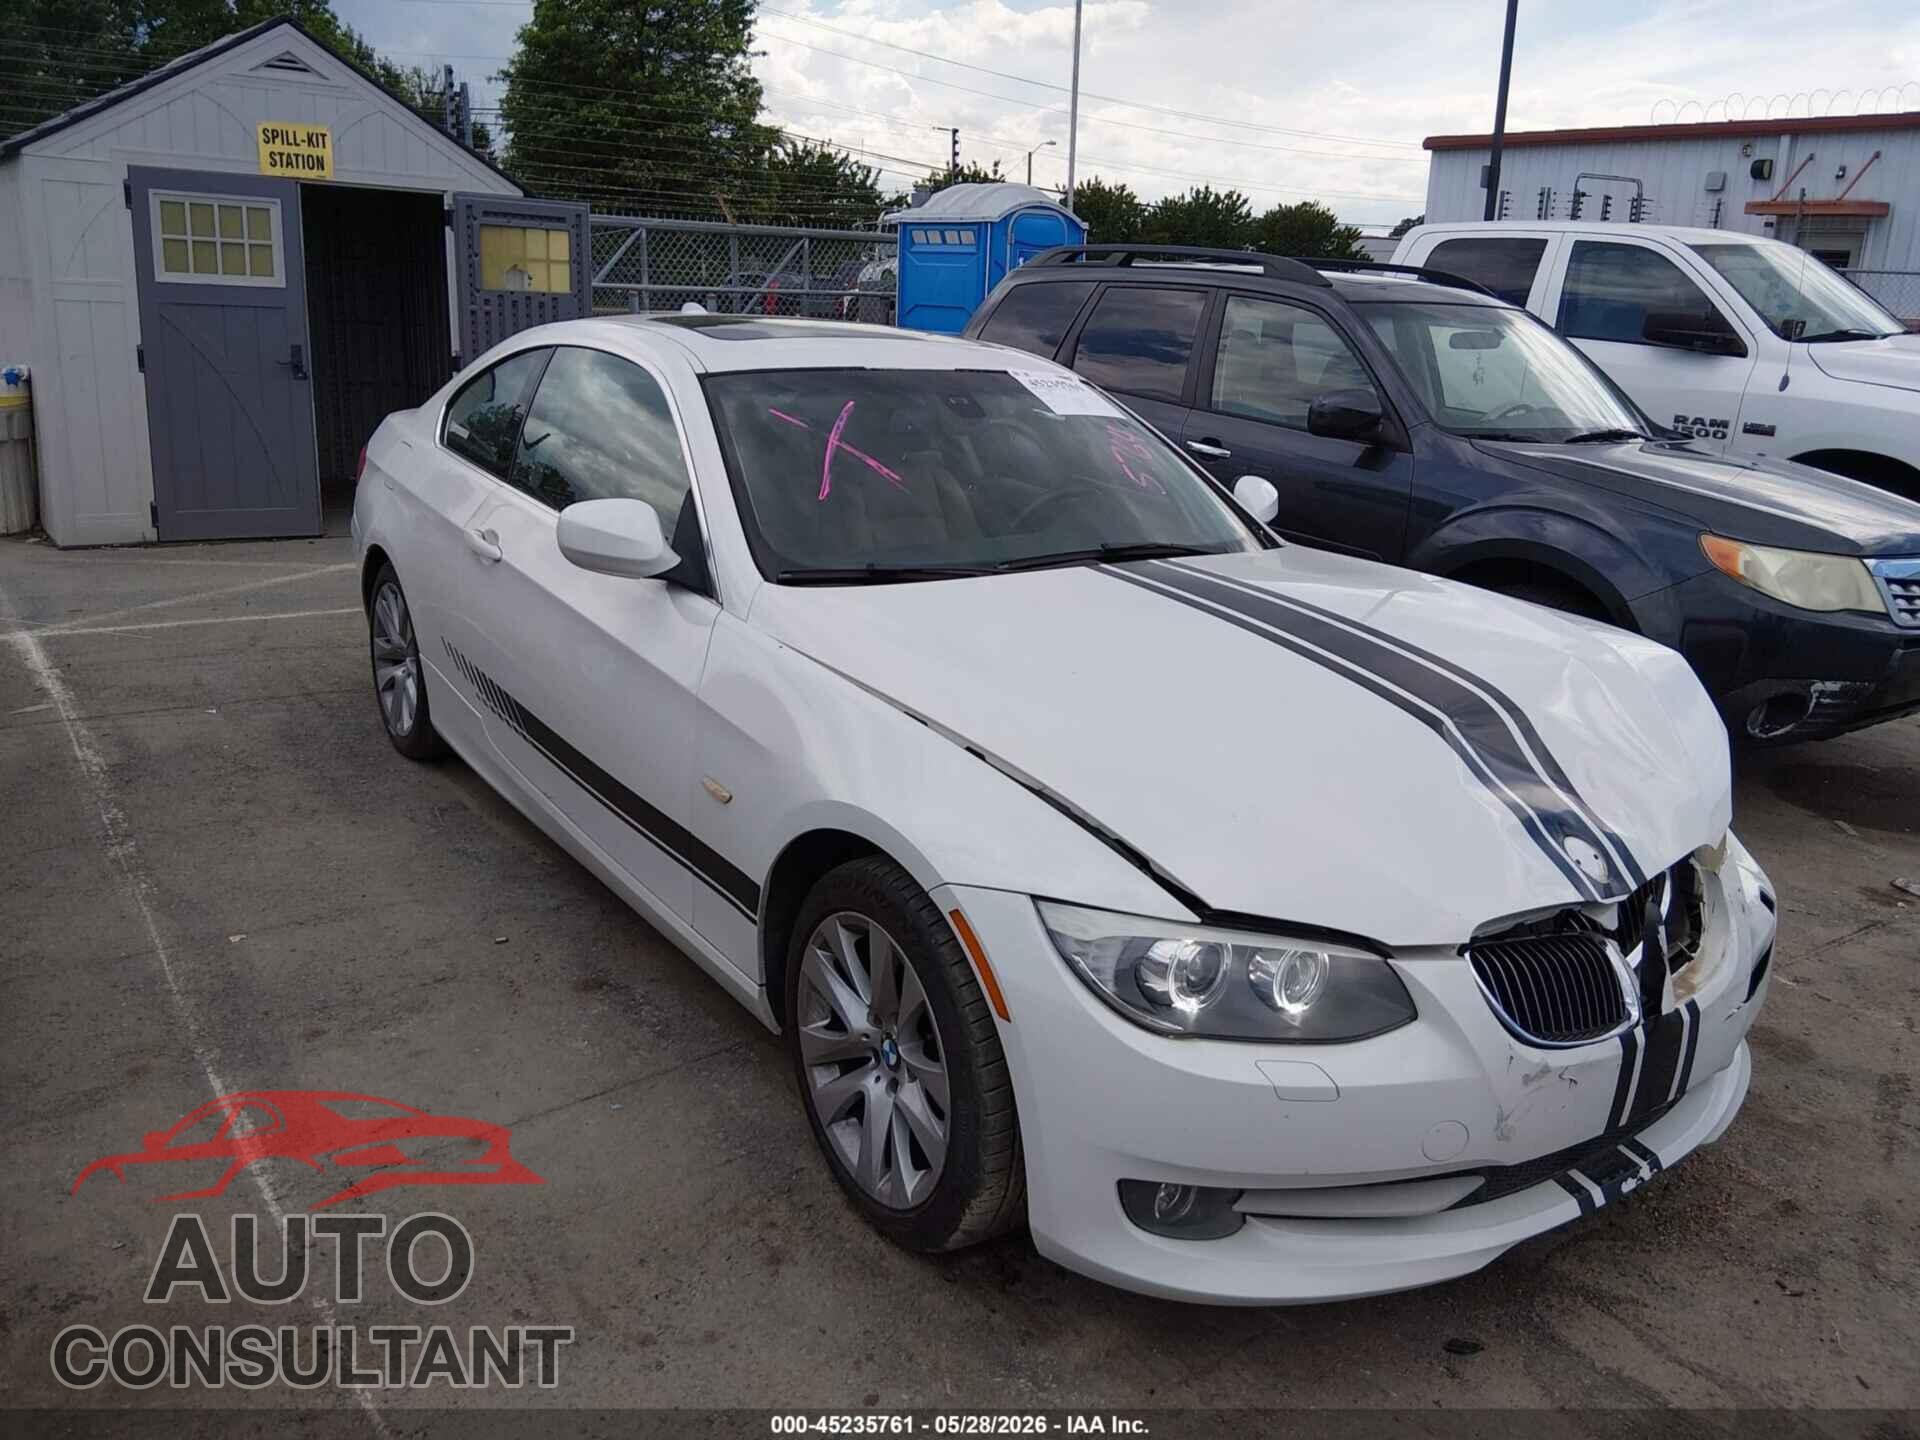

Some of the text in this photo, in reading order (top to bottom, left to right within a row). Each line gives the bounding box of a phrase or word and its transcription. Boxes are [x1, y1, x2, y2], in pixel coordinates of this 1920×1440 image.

[262, 128, 327, 149] SPILL-KIT
[269, 151, 325, 171] STATION
[1673, 415, 1730, 429] RAM
